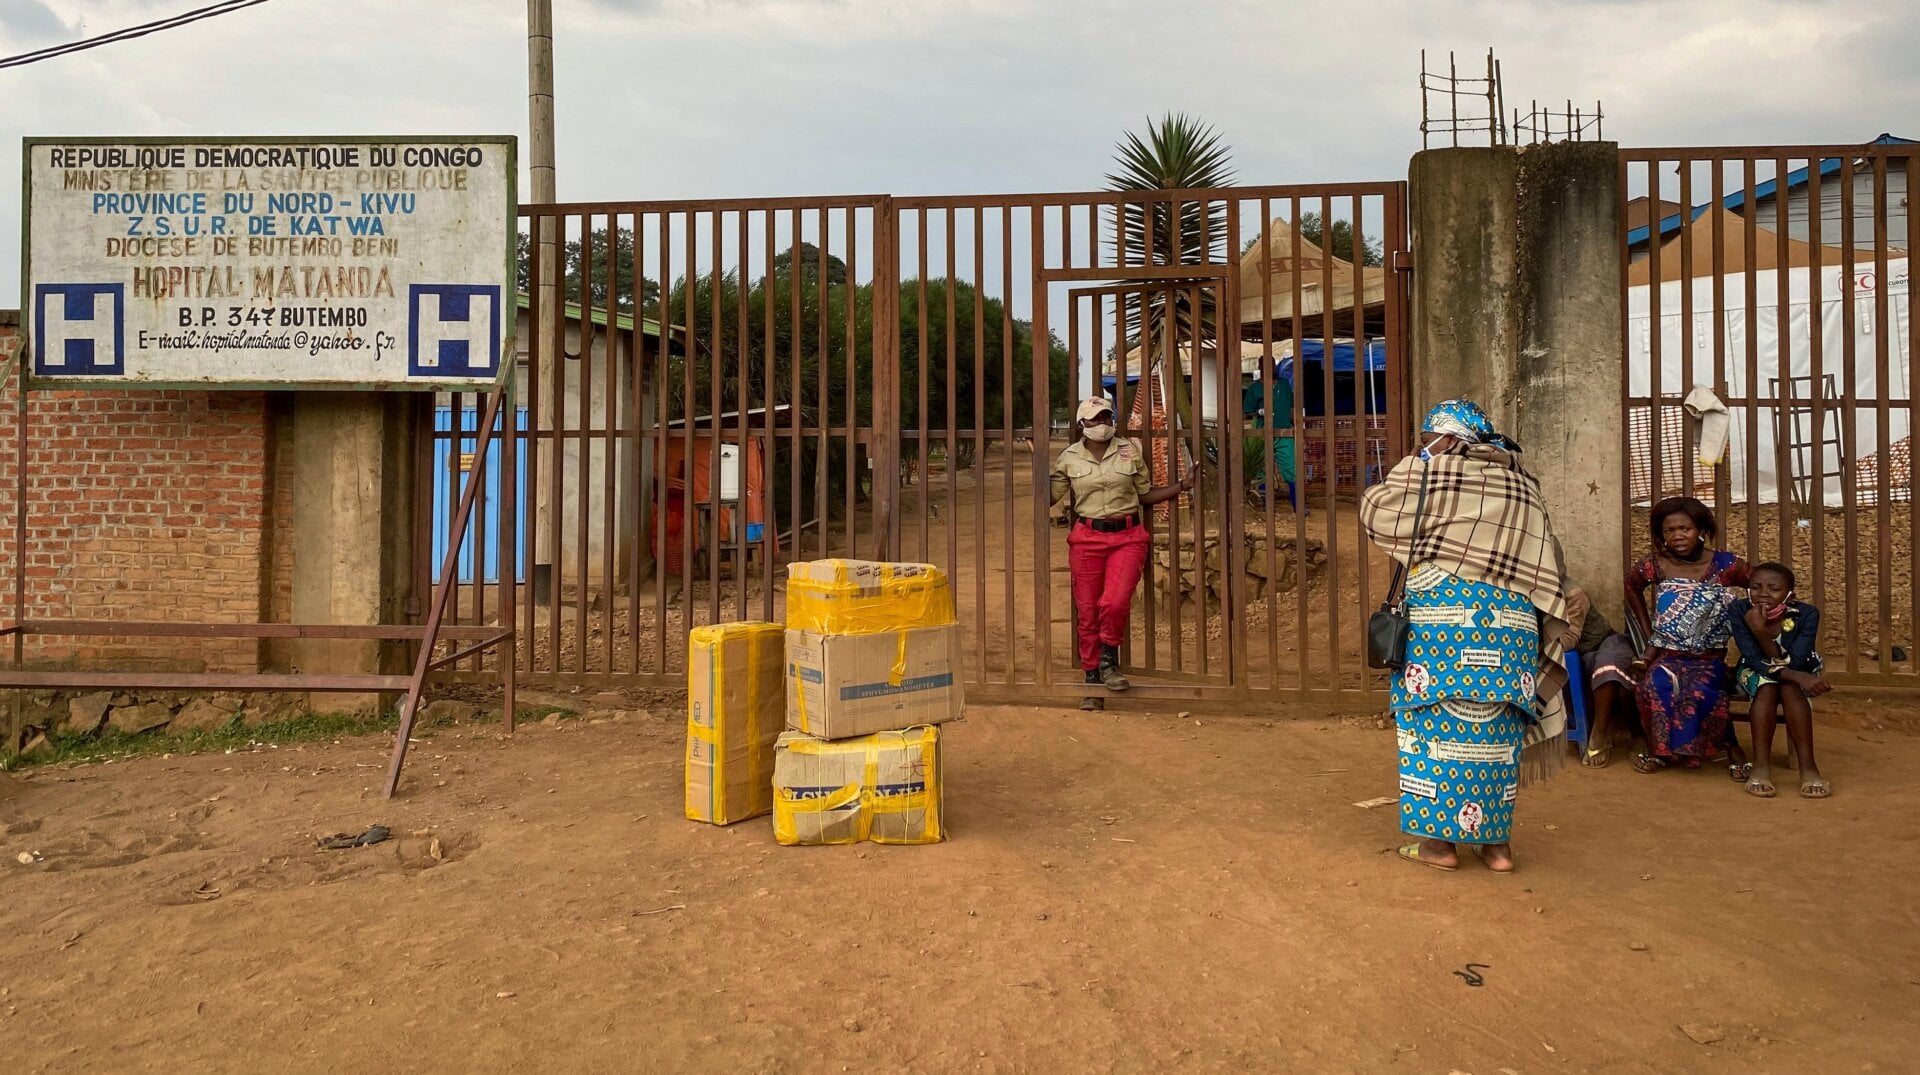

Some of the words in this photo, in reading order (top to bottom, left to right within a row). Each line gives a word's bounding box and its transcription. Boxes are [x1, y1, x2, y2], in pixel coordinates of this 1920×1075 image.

[50, 148, 185, 170] REPUBLIQUE
[195, 147, 360, 170] DEMOCRATIQUE
[369, 147, 396, 167] DU
[403, 147, 483, 168] CONGO
[186, 170, 214, 191] DE
[222, 169, 250, 191] LA
[93, 193, 207, 214] PROVINCE
[224, 193, 254, 214] DU
[248, 216, 277, 236] DE
[290, 216, 385, 236] KATWA
[106, 237, 197, 257] DIOCESE
[213, 237, 239, 257] DE
[133, 266, 240, 298] HOPITAL
[253, 265, 395, 298] MATANDA
[179, 306, 217, 327] B.P.
[228, 306, 276, 328] 347
[280, 307, 367, 327] BUTEMBO
[44, 293, 115, 366] H
[417, 293, 491, 368] H
